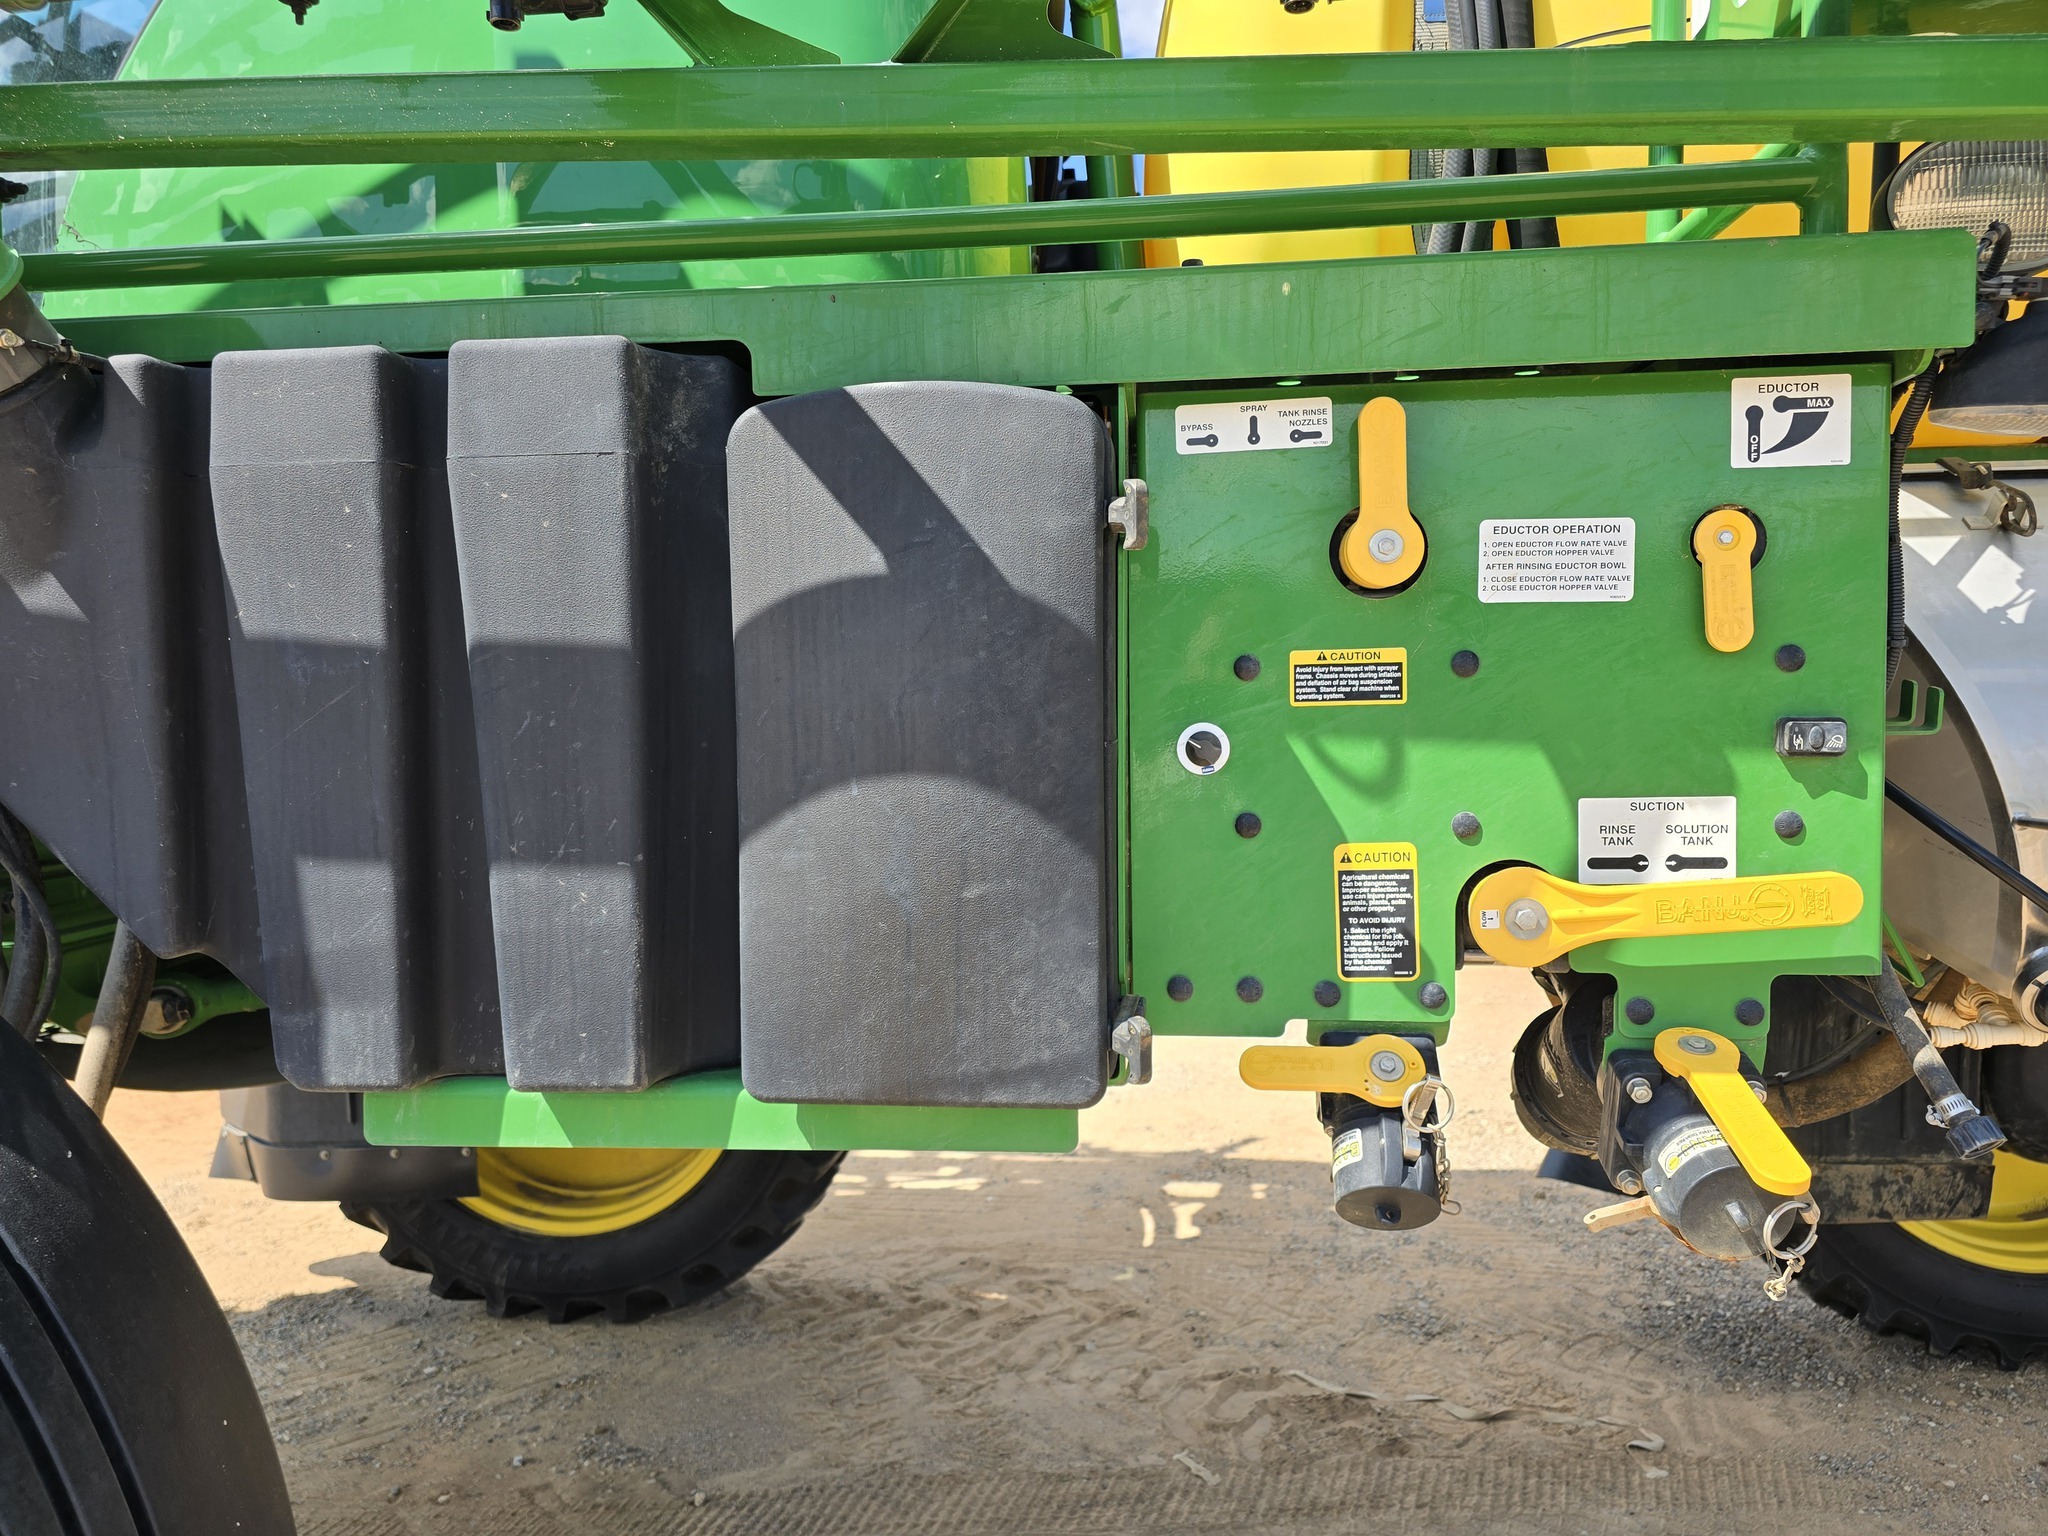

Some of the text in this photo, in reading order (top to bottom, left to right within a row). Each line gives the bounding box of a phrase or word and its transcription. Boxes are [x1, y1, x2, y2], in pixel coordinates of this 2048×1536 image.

[1759, 383, 1818, 393] EDUCTOR
[1807, 398, 1831, 408] MAX
[1303, 408, 1327, 416] RINSE
[1290, 418, 1327, 426] NOZZLES
[1181, 424, 1213, 432] BYPASS
[1750, 434, 1759, 461] OFF
[1494, 525, 1620, 534] EDUCTOR OPERATION
[1331, 652, 1380, 661] CAUTION
[1313, 666, 1329, 674] injury
[1330, 666, 1343, 674] from
[1364, 665, 1376, 673] with
[1360, 678, 1392, 686] suspension
[1630, 802, 1684, 811] SUCTION
[1600, 825, 1635, 834] RINSE
[1666, 825, 1728, 834] SOLUTION
[1602, 837, 1633, 845] TANK
[1681, 837, 1713, 845] TANK
[1355, 852, 1410, 863] CAUTION
